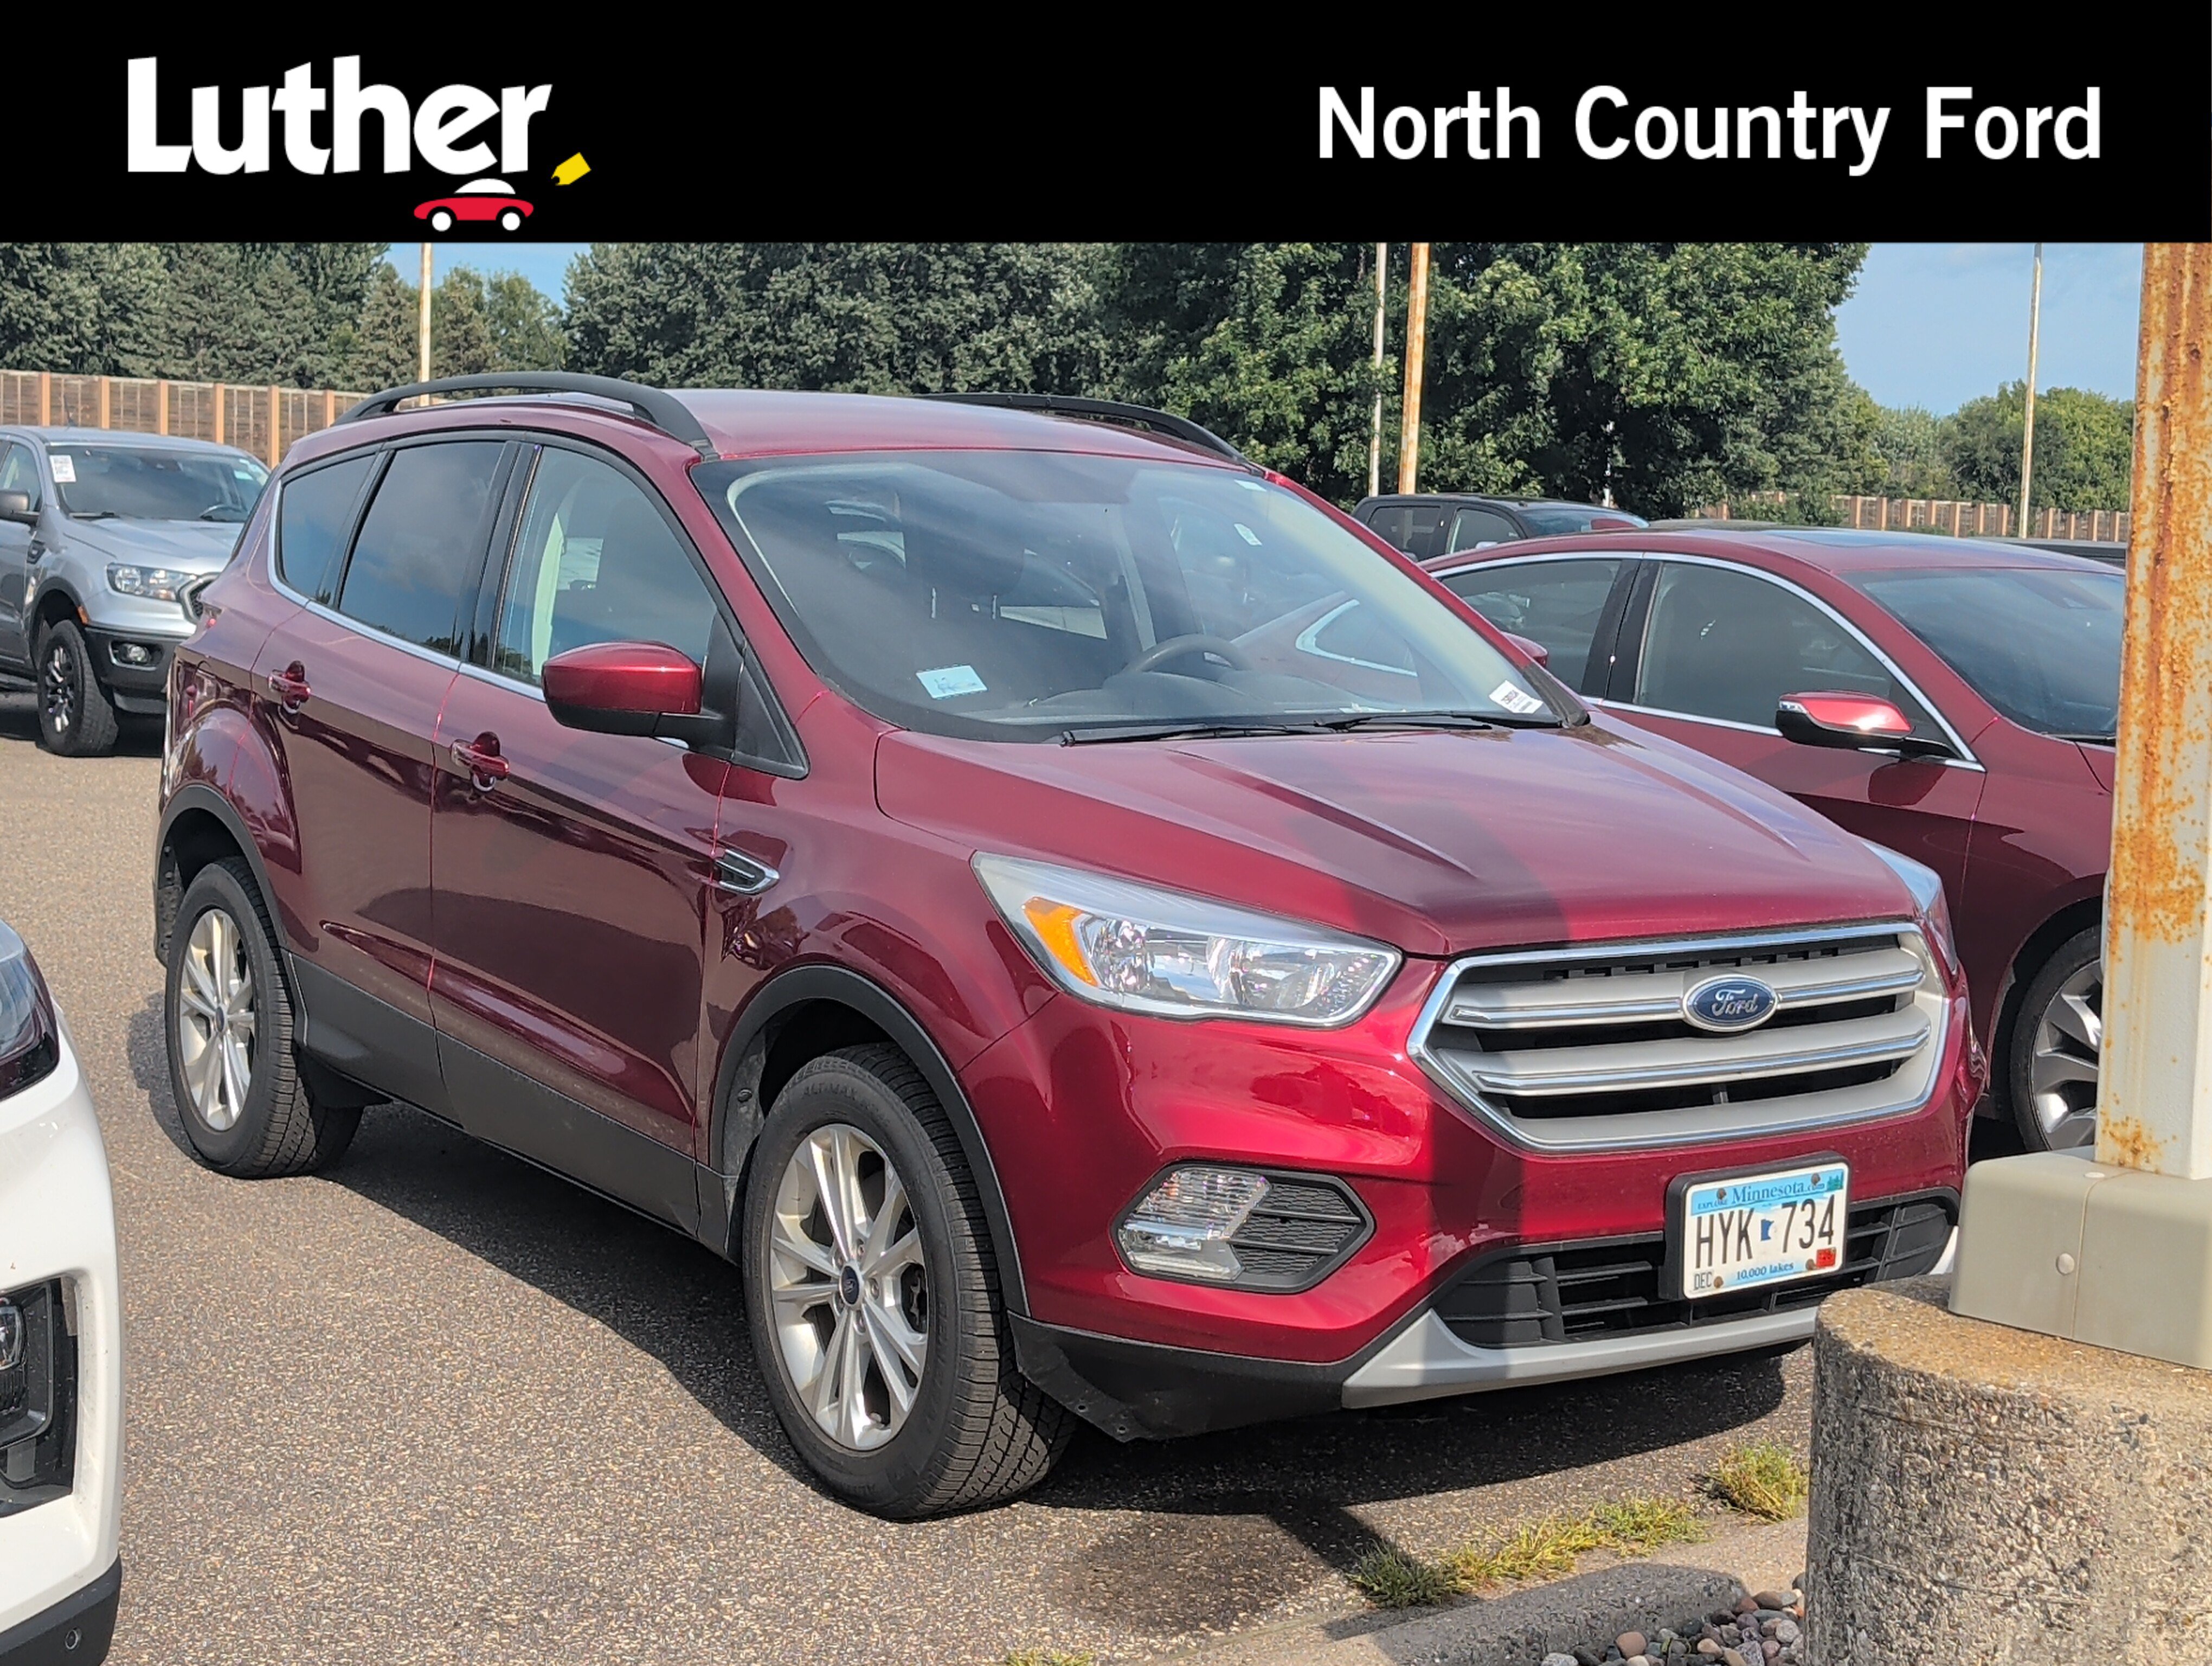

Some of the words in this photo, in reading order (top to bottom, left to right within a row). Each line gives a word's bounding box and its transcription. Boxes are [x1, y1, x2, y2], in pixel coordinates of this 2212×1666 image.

[1711, 989, 1758, 1016] Ford
[1695, 1208, 1754, 1269] HYK
[1782, 1194, 1835, 1253] 734
[1694, 1272, 1712, 1290] DEC
